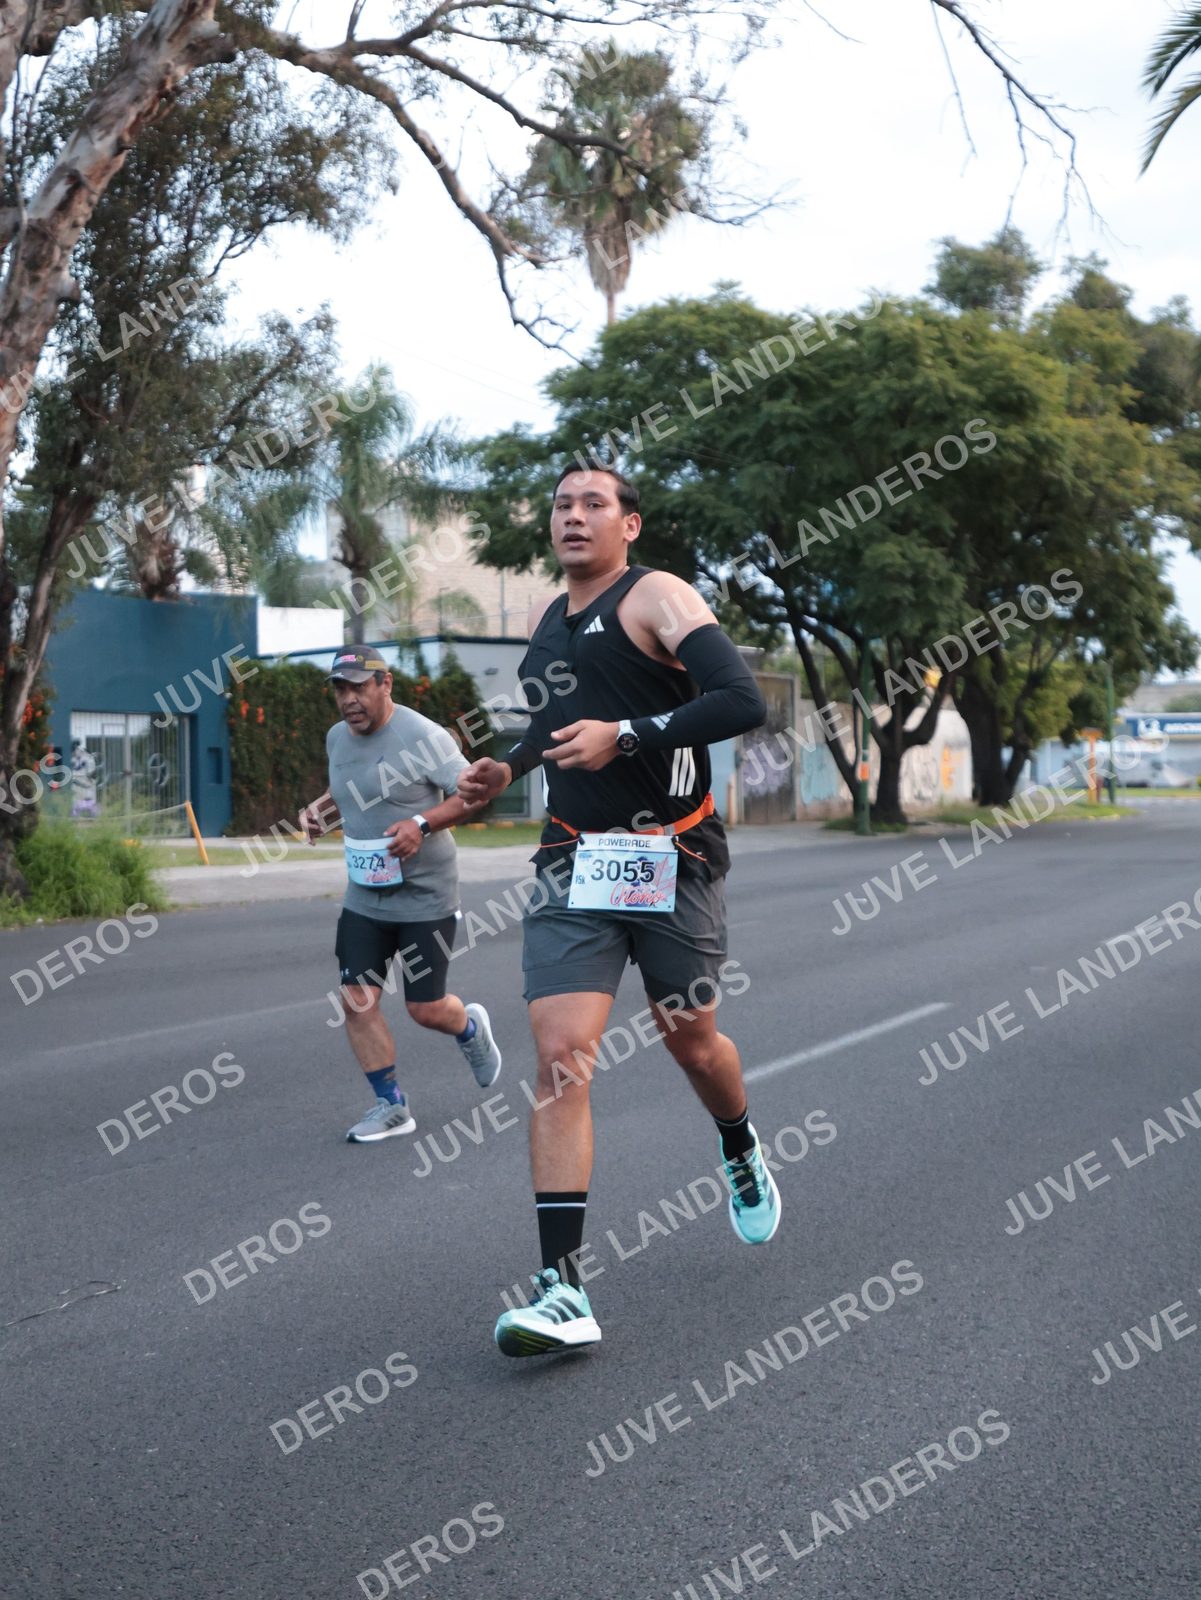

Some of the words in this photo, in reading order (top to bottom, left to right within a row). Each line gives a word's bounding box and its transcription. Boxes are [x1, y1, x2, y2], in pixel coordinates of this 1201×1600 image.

[597, 838, 651, 848] POWERADE
[352, 855, 385, 870] 3274
[590, 859, 655, 883] 3055
